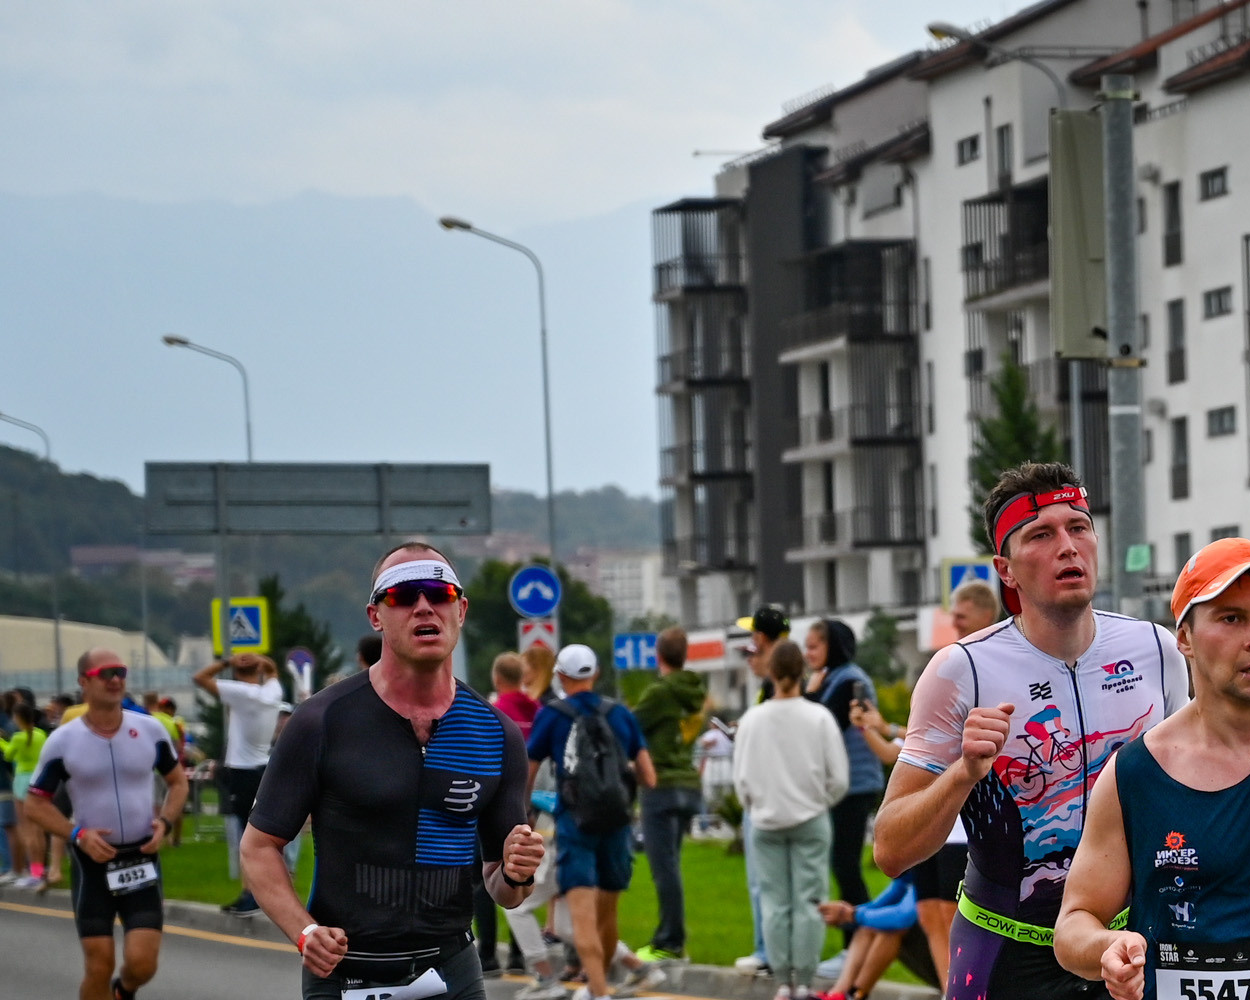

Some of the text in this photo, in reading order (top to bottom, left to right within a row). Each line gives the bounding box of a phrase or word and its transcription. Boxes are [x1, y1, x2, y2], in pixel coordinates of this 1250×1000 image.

[1053, 491, 1075, 500] 2XU
[1156, 848, 1196, 860] ИНТЕР
[976, 912, 1015, 935] POW
[1159, 943, 1173, 951] IRON
[1160, 951, 1180, 963] STAR
